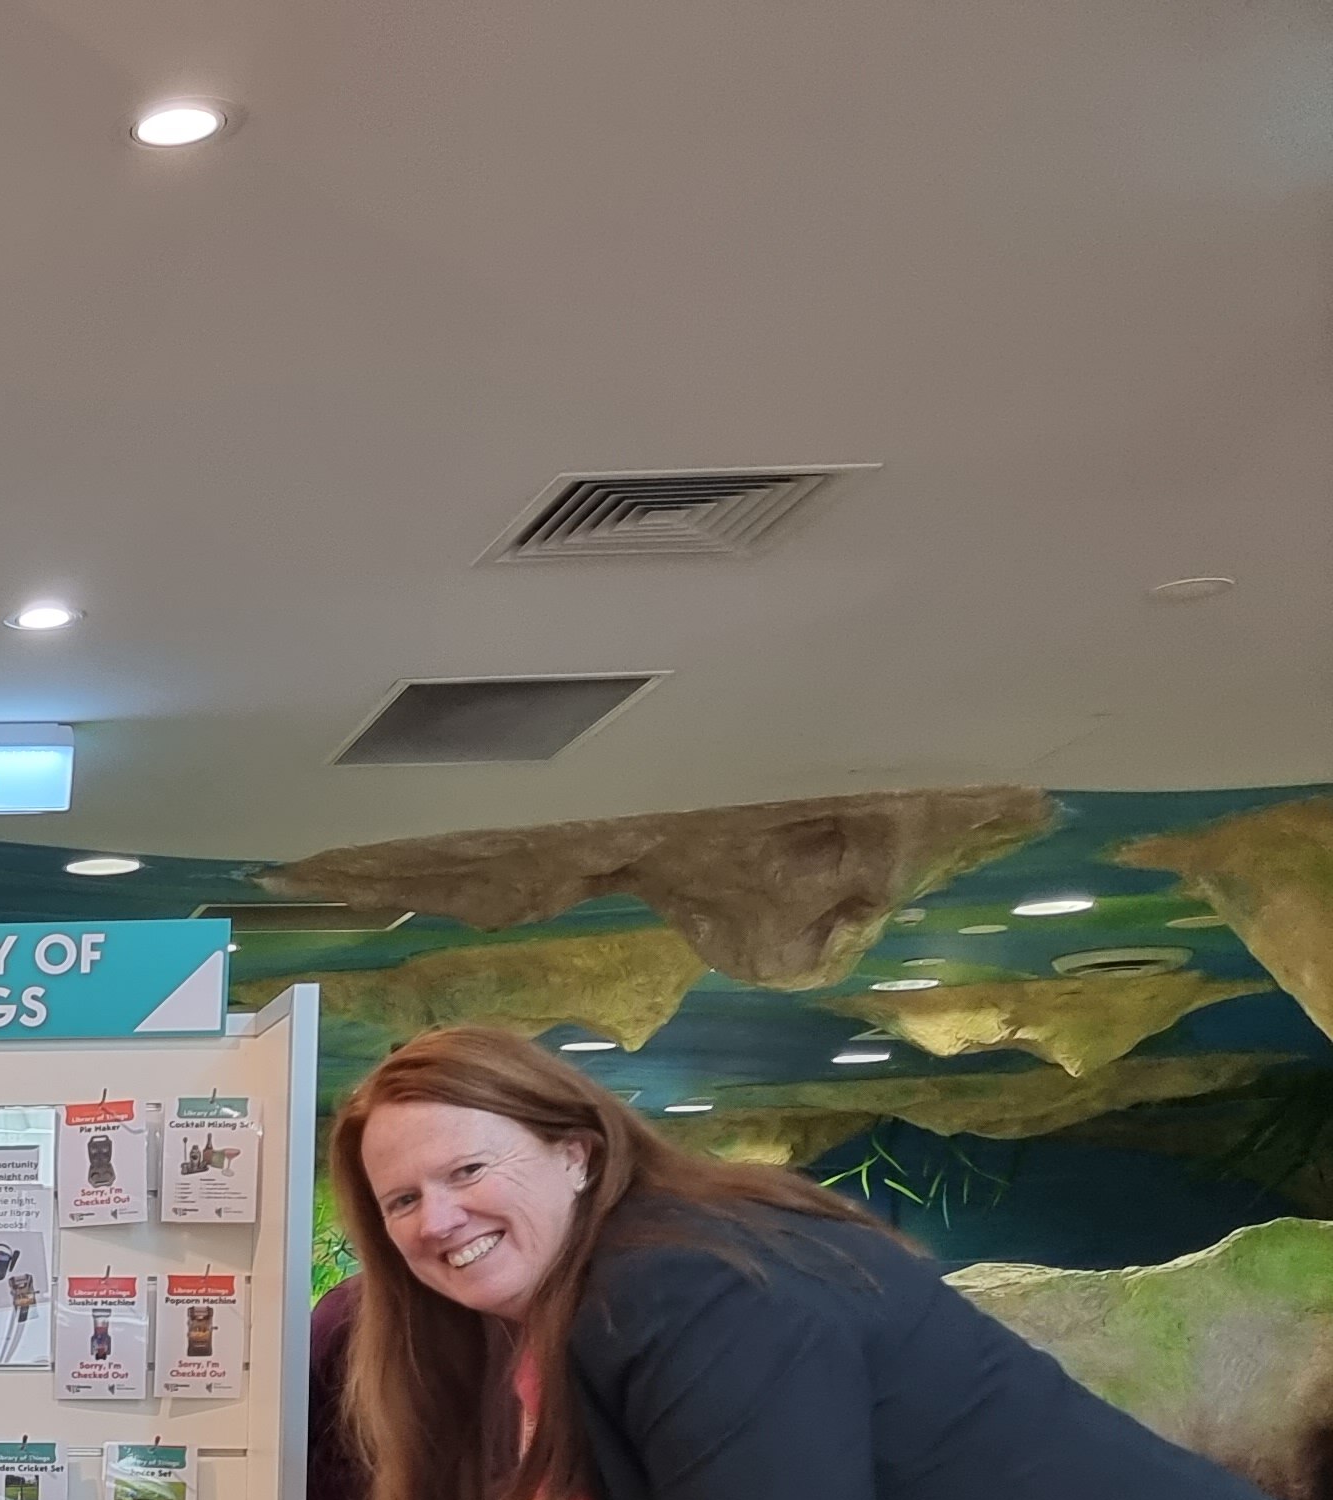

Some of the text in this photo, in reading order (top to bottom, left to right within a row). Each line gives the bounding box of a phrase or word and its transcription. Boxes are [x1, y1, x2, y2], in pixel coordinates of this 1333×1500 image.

[34, 933, 105, 975] OF
[79, 1124, 120, 1133] Pie Maker
[169, 1121, 237, 1130] Cocktail Mixing
[80, 1188, 106, 1197] Sorry,
[74, 1196, 130, 1207] Checked Out
[10, 1209, 40, 1218] library
[165, 1297, 236, 1305] Popcorn Machine
[17, 1464, 48, 1473] Cricket
[50, 1465, 64, 1473] Set
[158, 1470, 172, 1478] Set
